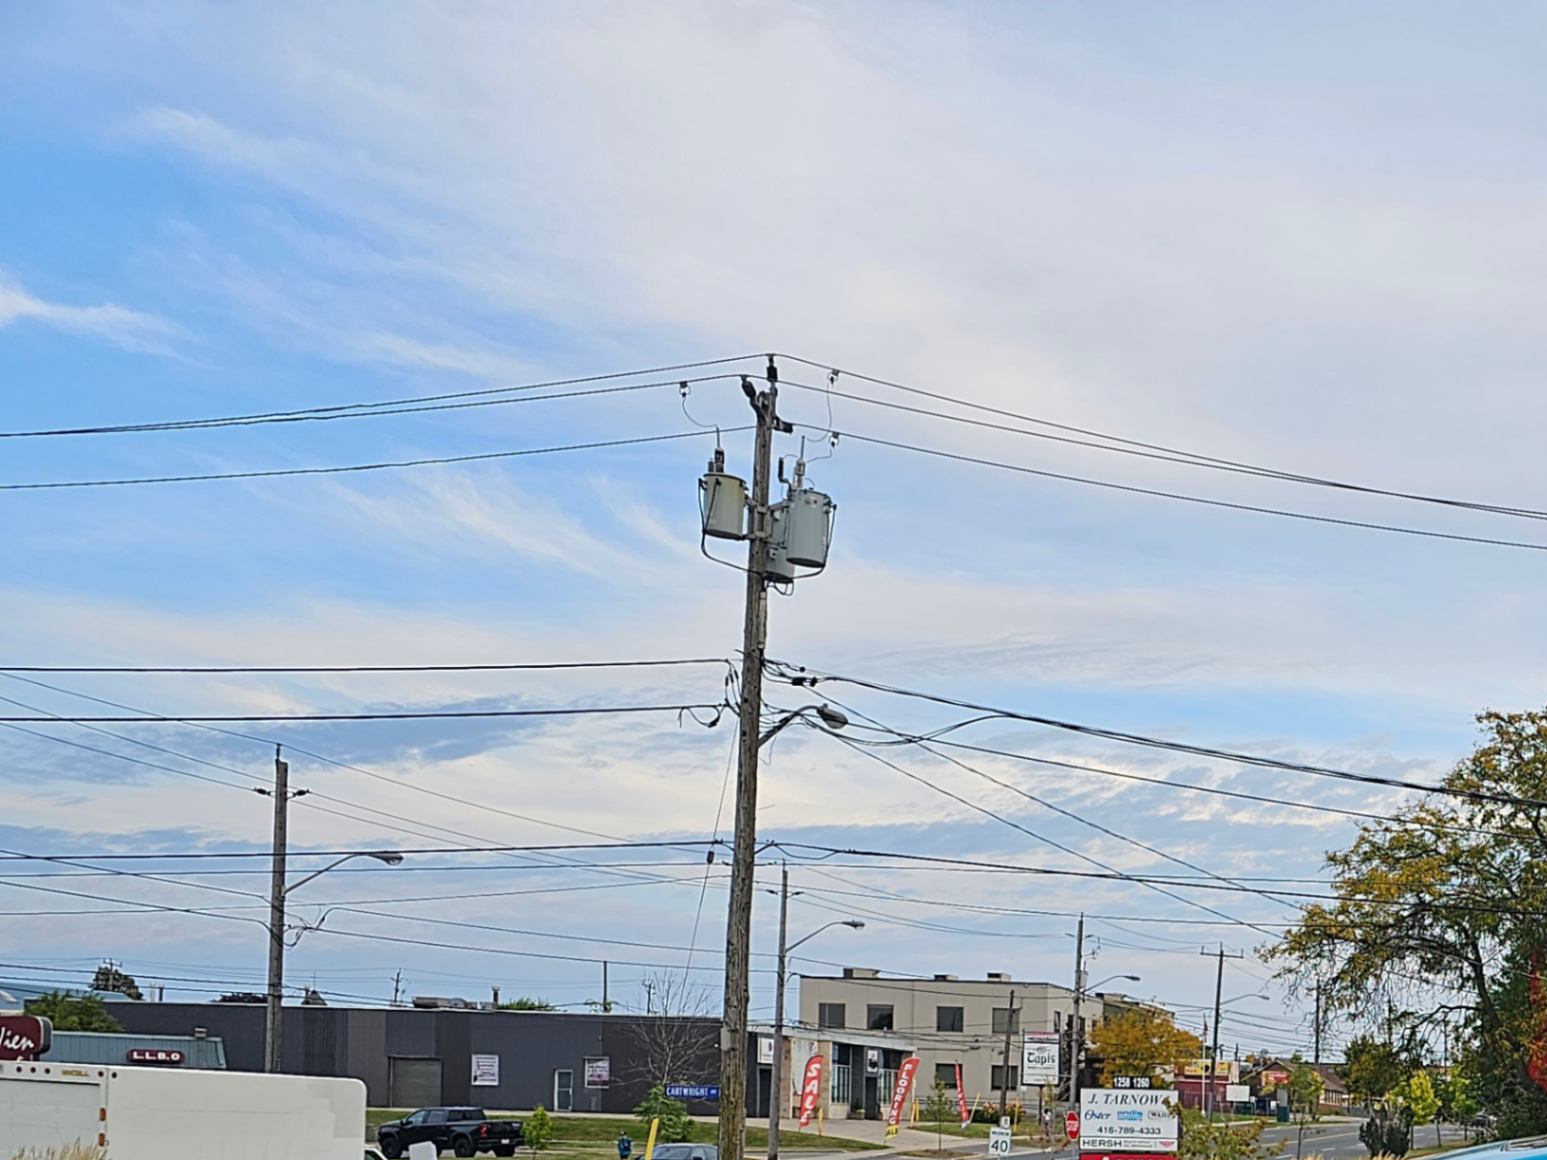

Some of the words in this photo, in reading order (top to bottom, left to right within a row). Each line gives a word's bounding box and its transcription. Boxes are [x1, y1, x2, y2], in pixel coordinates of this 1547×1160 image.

[1027, 1051, 1056, 1066] Tapis
[666, 1087, 708, 1096] CARTWRIGHT
[800, 1063, 821, 1122] SALE
[889, 1063, 913, 1125] FLOORING
[1088, 1093, 1098, 1104] J.
[991, 1139, 1009, 1152] 40
[1082, 1140, 1122, 1148] HERSH
